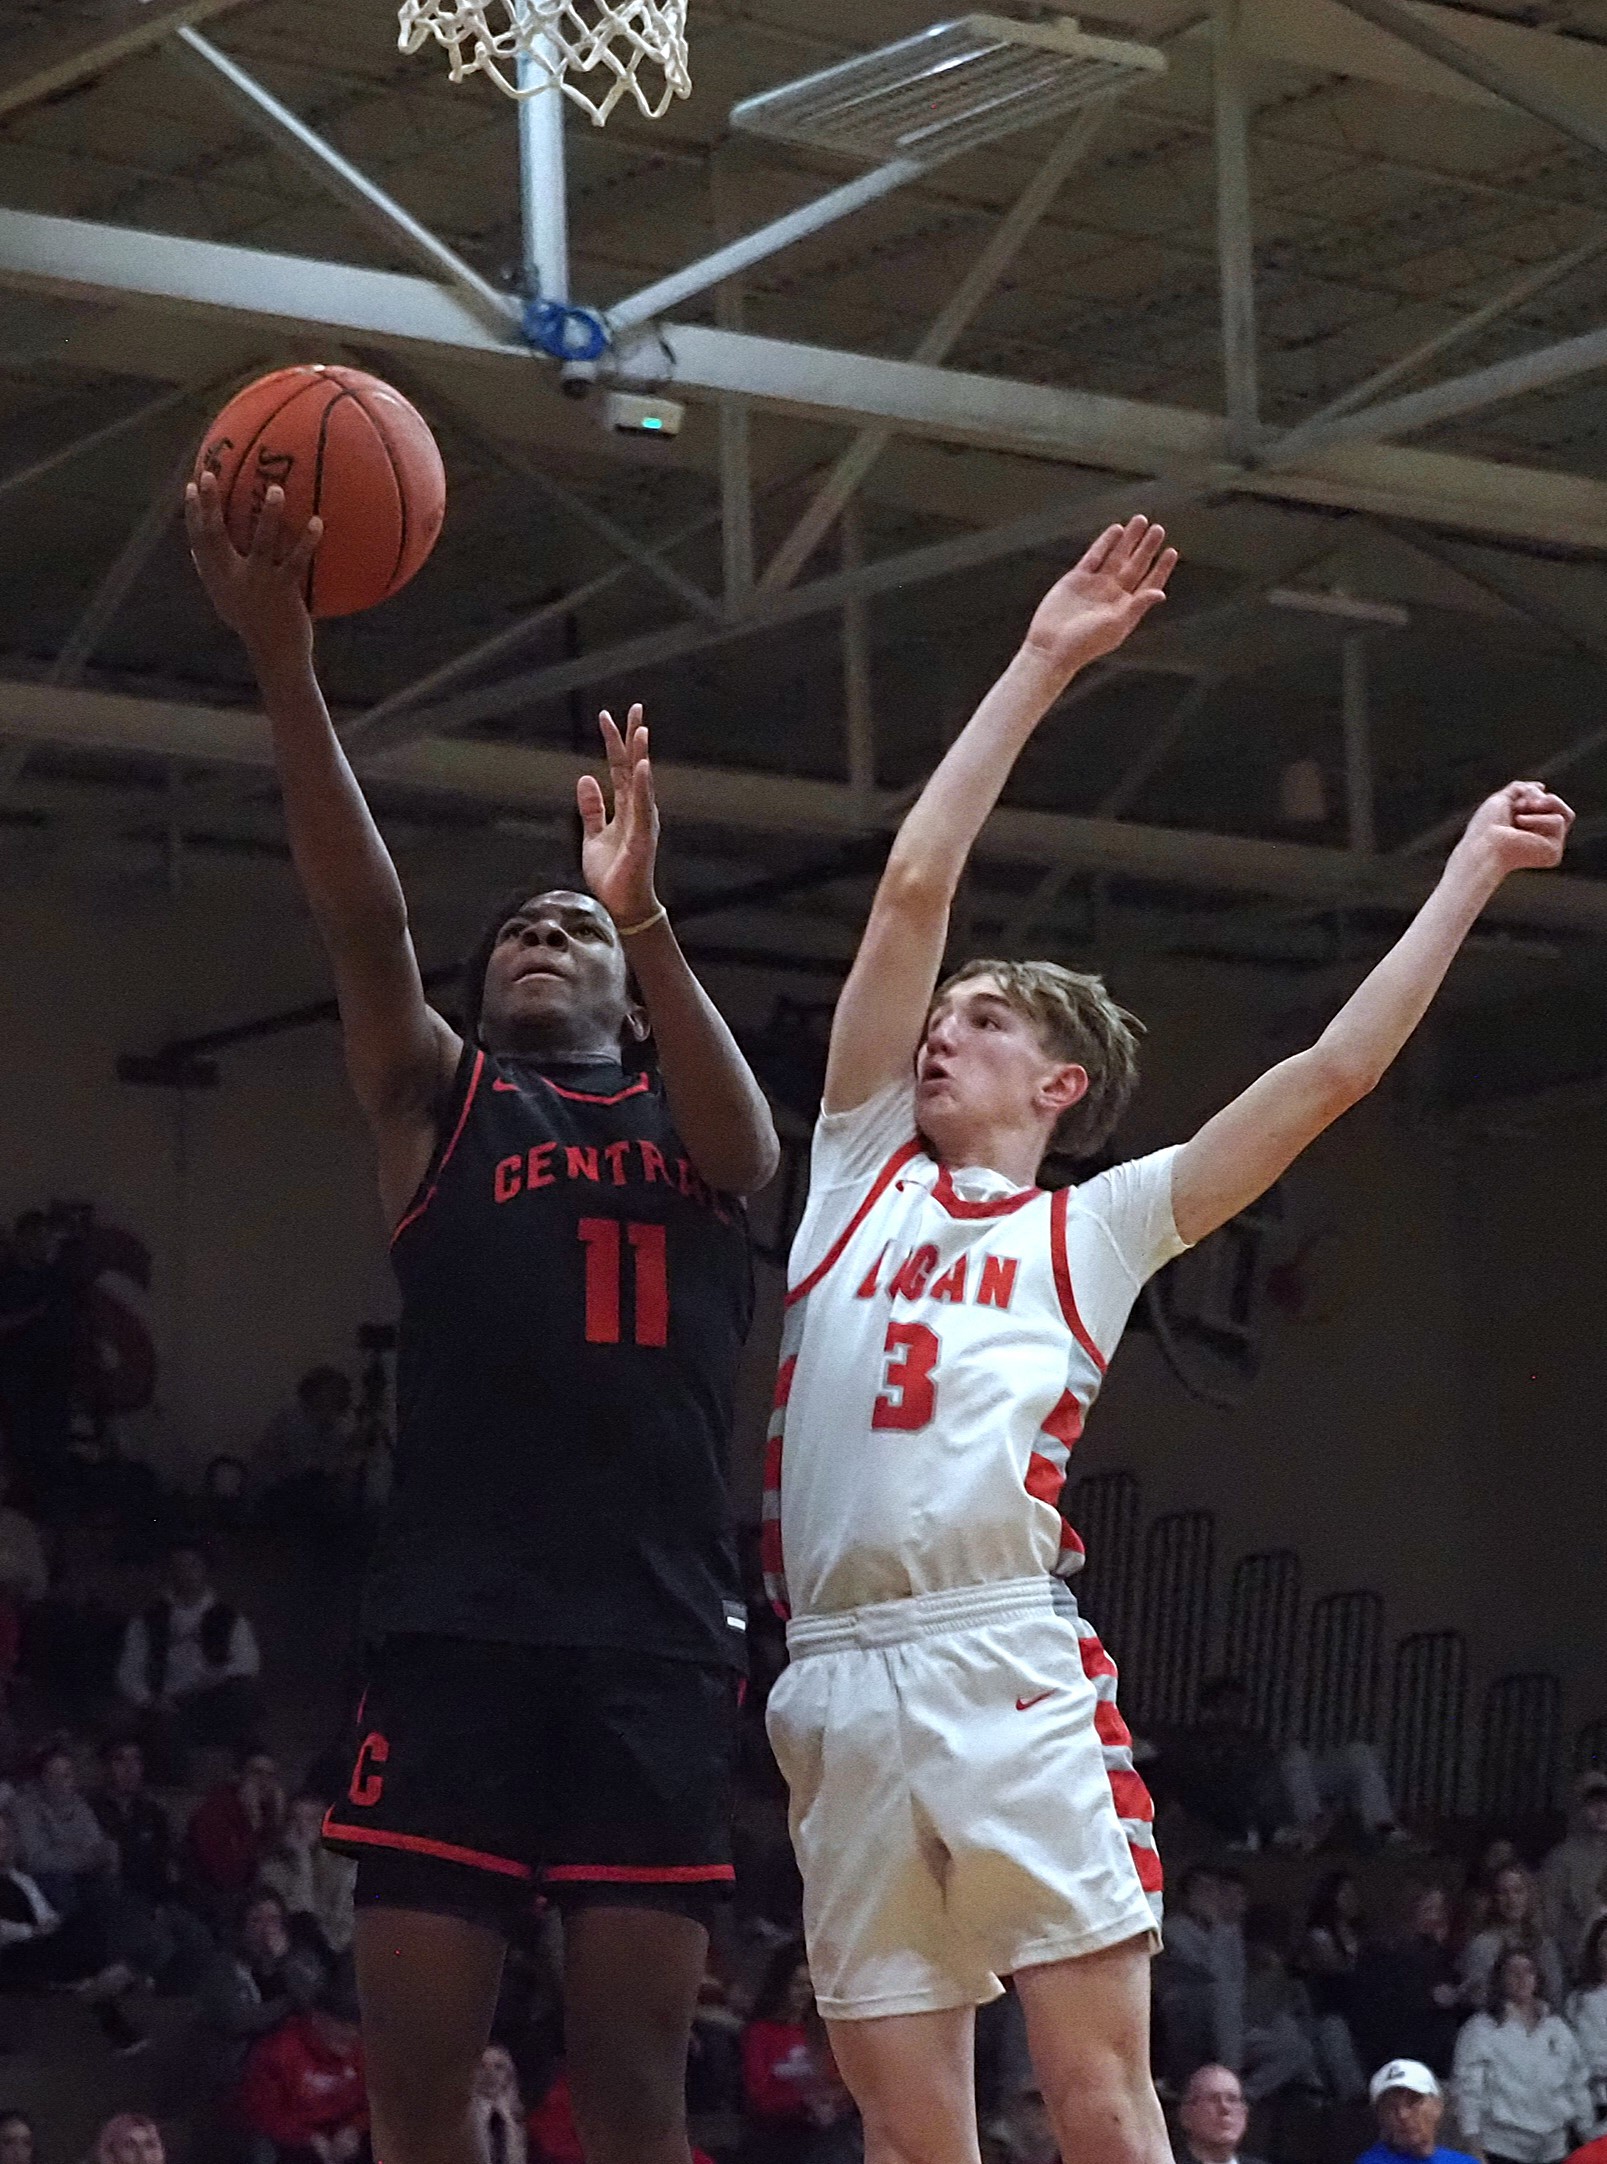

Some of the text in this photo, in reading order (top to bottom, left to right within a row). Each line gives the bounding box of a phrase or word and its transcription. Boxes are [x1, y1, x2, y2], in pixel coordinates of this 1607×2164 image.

[578, 1218, 668, 1347] 11
[871, 1321, 940, 1431] 3
[350, 1731, 389, 1806] C
